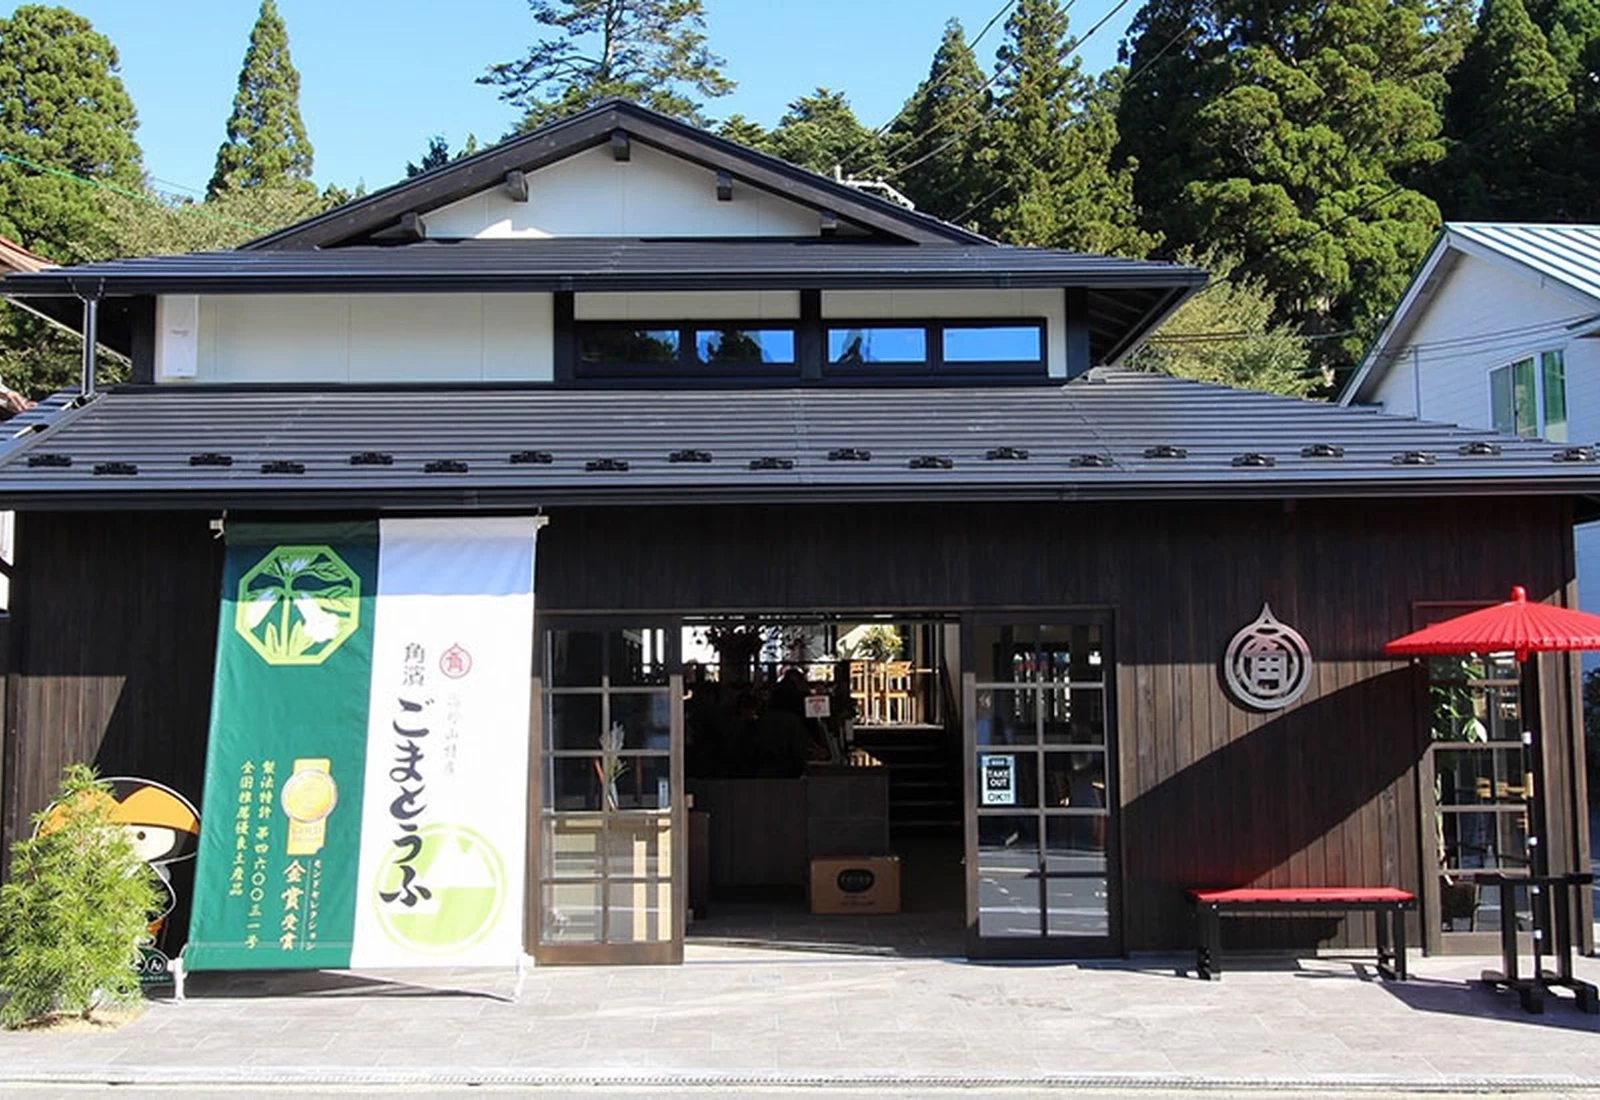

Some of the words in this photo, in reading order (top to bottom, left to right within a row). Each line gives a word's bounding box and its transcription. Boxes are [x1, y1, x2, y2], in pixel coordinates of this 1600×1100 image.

[987, 770, 1008, 778] TAKE
[990, 779, 1007, 787] OUT
[379, 698, 434, 908] ごまとうふ
[280, 859, 306, 950] 金賞受賞
